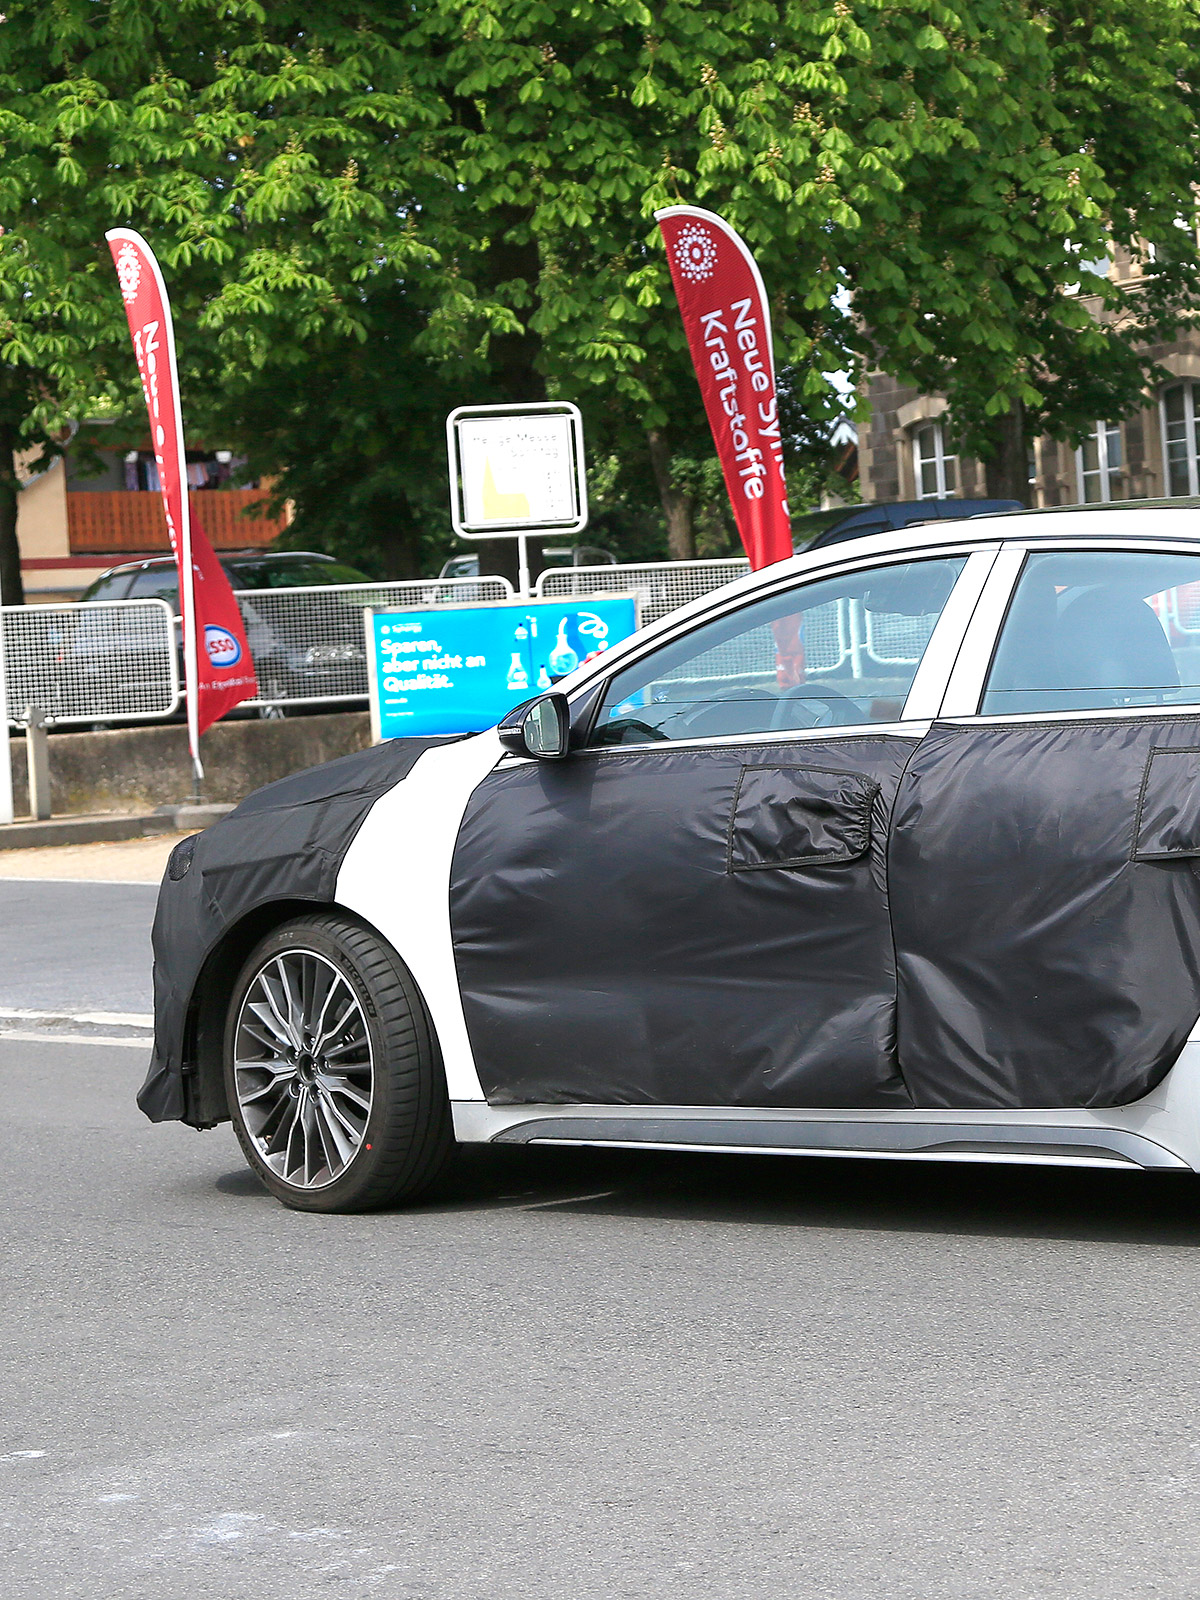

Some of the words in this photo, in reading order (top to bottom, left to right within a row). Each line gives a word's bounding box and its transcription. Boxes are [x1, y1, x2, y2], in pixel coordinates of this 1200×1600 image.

[730, 297, 769, 392] Neue
[700, 308, 766, 500] Kraftstoffe
[381, 639, 443, 658] Sparen,
[382, 655, 420, 673] aber
[422, 653, 463, 670] nicht
[465, 655, 486, 668] an
[383, 673, 455, 692] Qualität.
